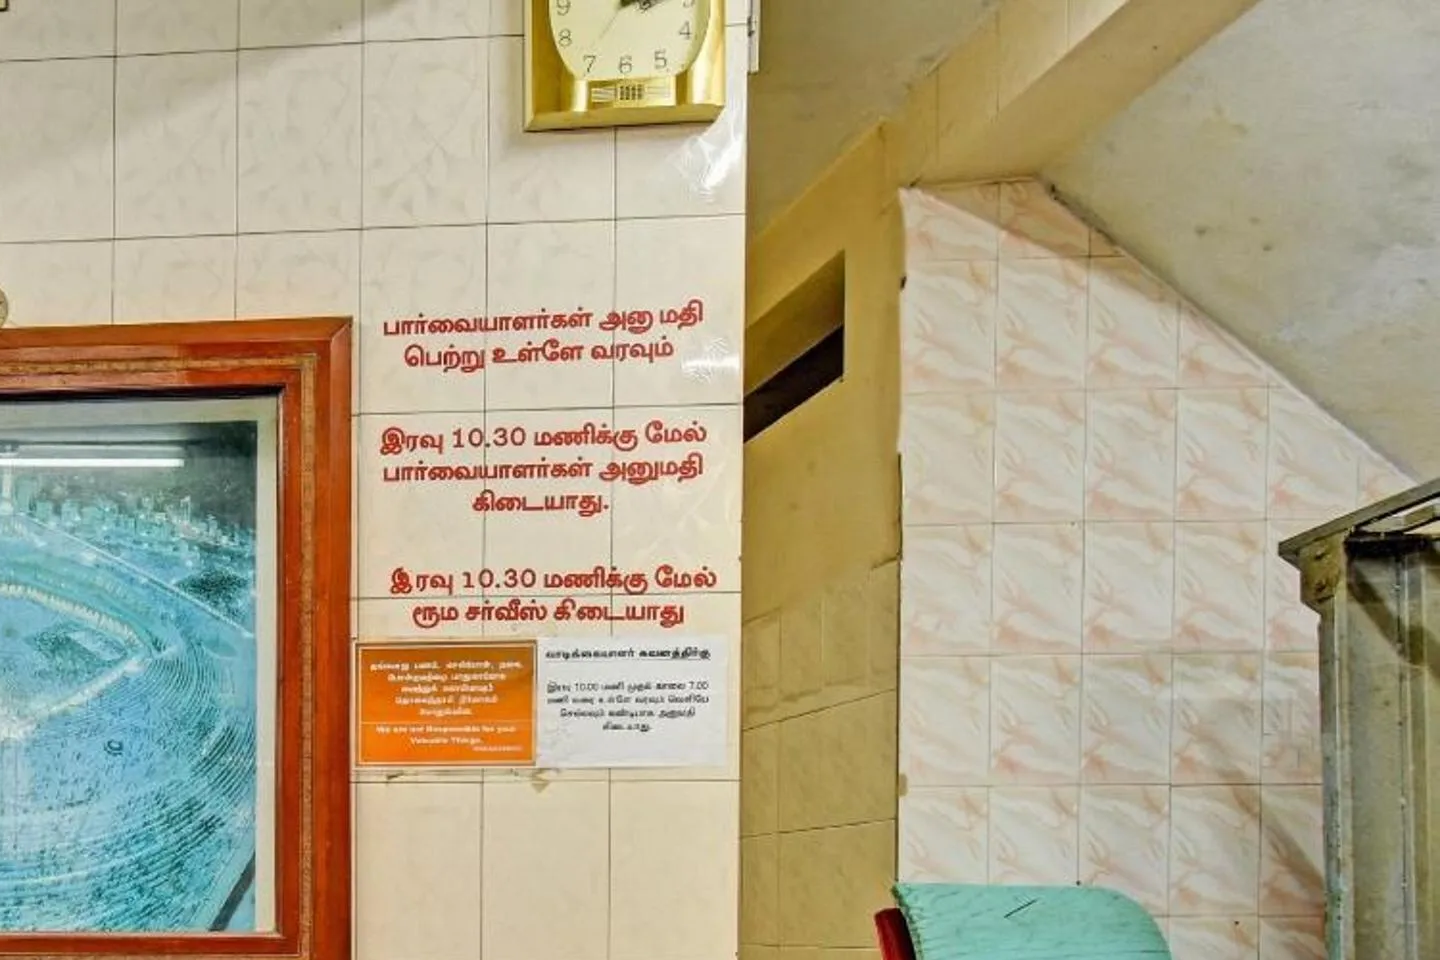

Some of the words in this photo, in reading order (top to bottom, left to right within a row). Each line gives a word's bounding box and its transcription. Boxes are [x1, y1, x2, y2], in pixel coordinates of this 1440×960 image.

[558, 28, 573, 48] 8
[678, 20, 692, 41] 4
[583, 54, 597, 74] 7
[618, 55, 633, 75] 6
[654, 50, 668, 70] 5
[383, 305, 593, 337] பார்வையாளர்கள்
[403, 342, 487, 374] பெற்று
[491, 337, 586, 366] உள்ளே
[590, 335, 675, 363] வரவும்
[378, 425, 445, 456] இரவு
[452, 427, 527, 450] 10.30
[534, 422, 639, 452] மணிக்கு
[644, 419, 707, 446] மேல்
[383, 458, 593, 483] பார்வையாளர்கள்
[598, 452, 704, 487] அனுமதி
[471, 489, 610, 518] கிடையாது.
[388, 567, 454, 596] இரவு
[462, 567, 537, 590] 10.30
[543, 564, 649, 594] மணிக்கு
[654, 563, 718, 589] மேல்
[464, 597, 548, 623] சர்வீஸ்
[553, 596, 685, 630] கிடையாது
